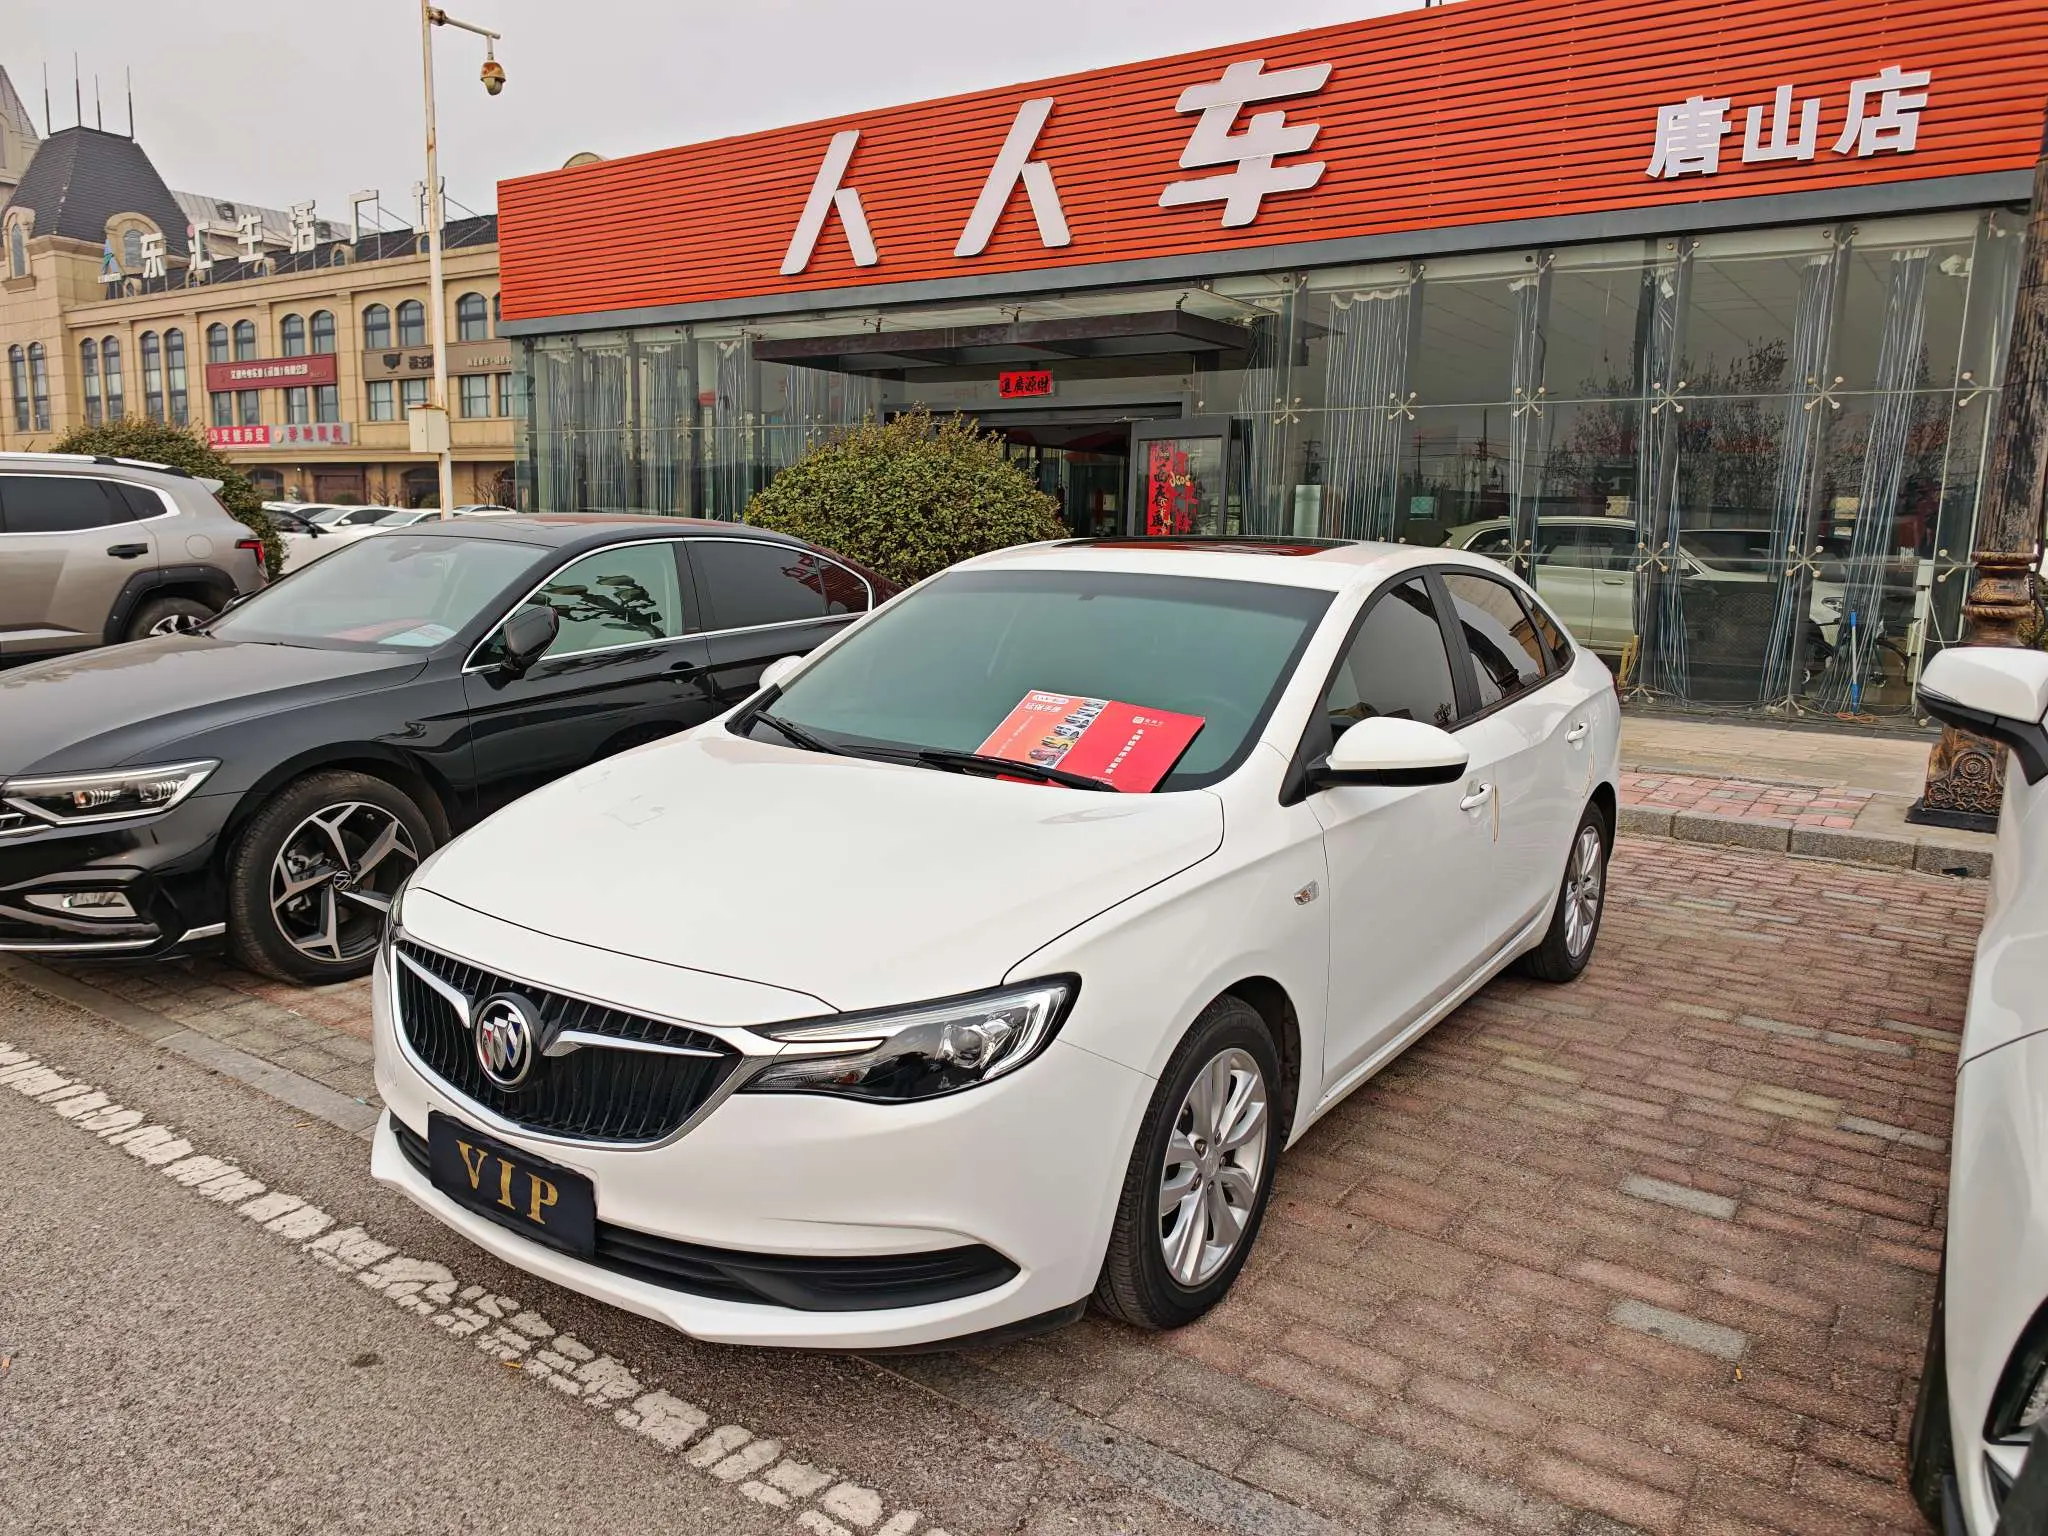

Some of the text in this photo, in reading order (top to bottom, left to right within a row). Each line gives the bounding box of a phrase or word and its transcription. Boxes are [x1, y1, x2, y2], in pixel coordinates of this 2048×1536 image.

[780, 59, 1332, 276] 人人车
[1645, 65, 1932, 178] 唐山店
[456, 1139, 559, 1225] VIP
